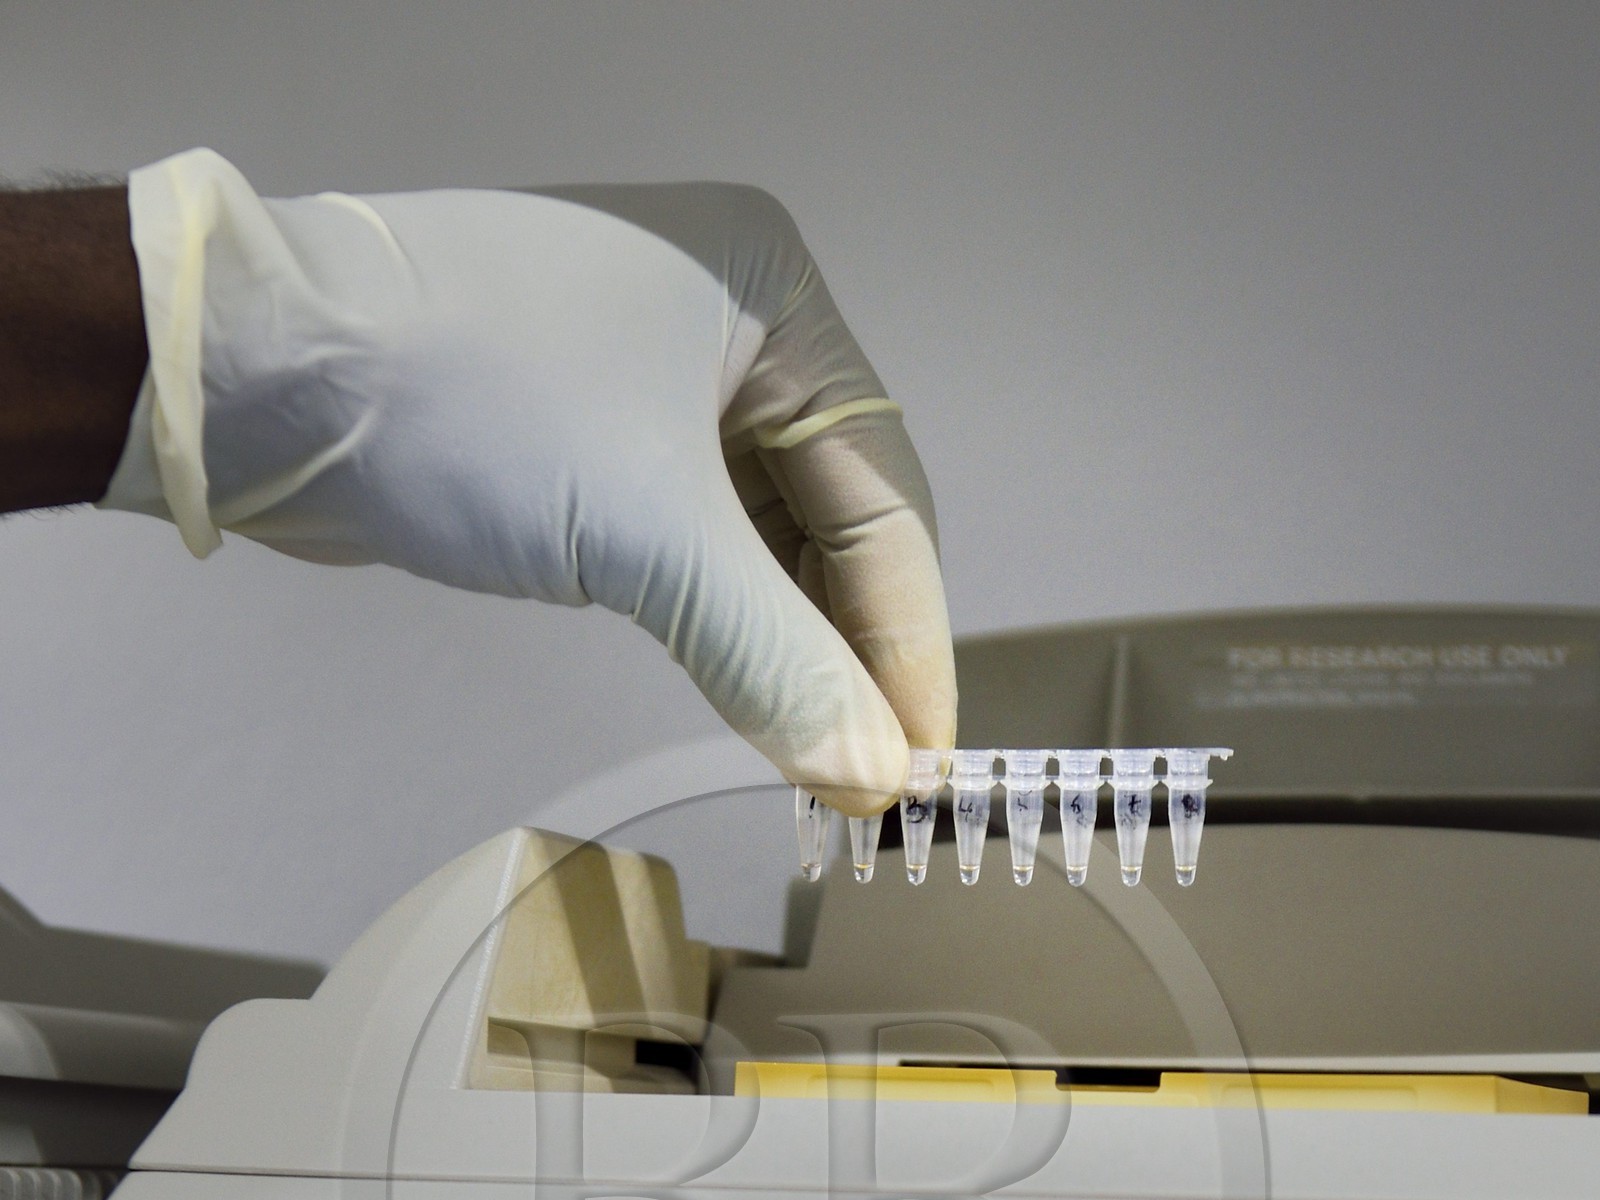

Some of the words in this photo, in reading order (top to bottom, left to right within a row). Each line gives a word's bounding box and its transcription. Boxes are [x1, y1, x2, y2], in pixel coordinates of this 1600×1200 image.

[1227, 645, 1282, 668] FOR
[1288, 645, 1434, 668] RESEARCH
[1438, 645, 1492, 668] USE
[1499, 645, 1569, 668] ONLY
